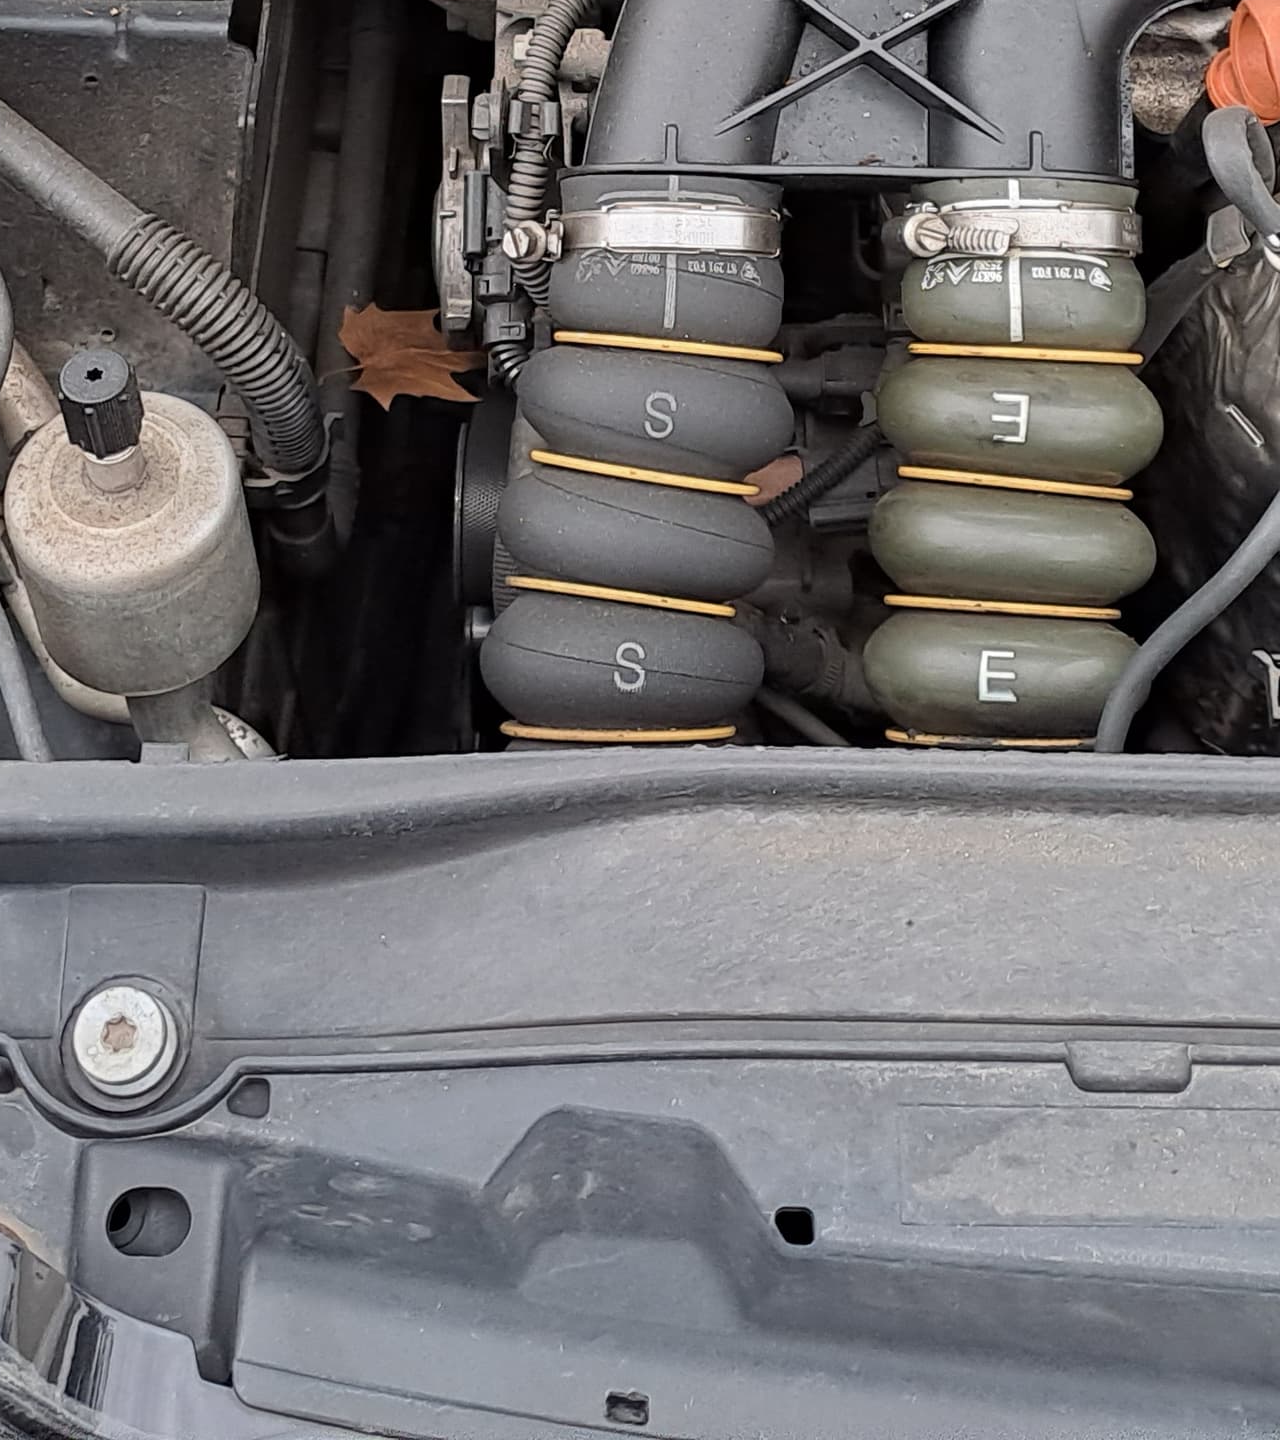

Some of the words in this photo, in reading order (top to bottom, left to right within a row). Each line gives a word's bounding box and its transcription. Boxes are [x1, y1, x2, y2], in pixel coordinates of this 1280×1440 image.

[642, 390, 679, 440] S
[991, 392, 1031, 445] E
[613, 640, 647, 694] S
[977, 649, 1019, 704] E
